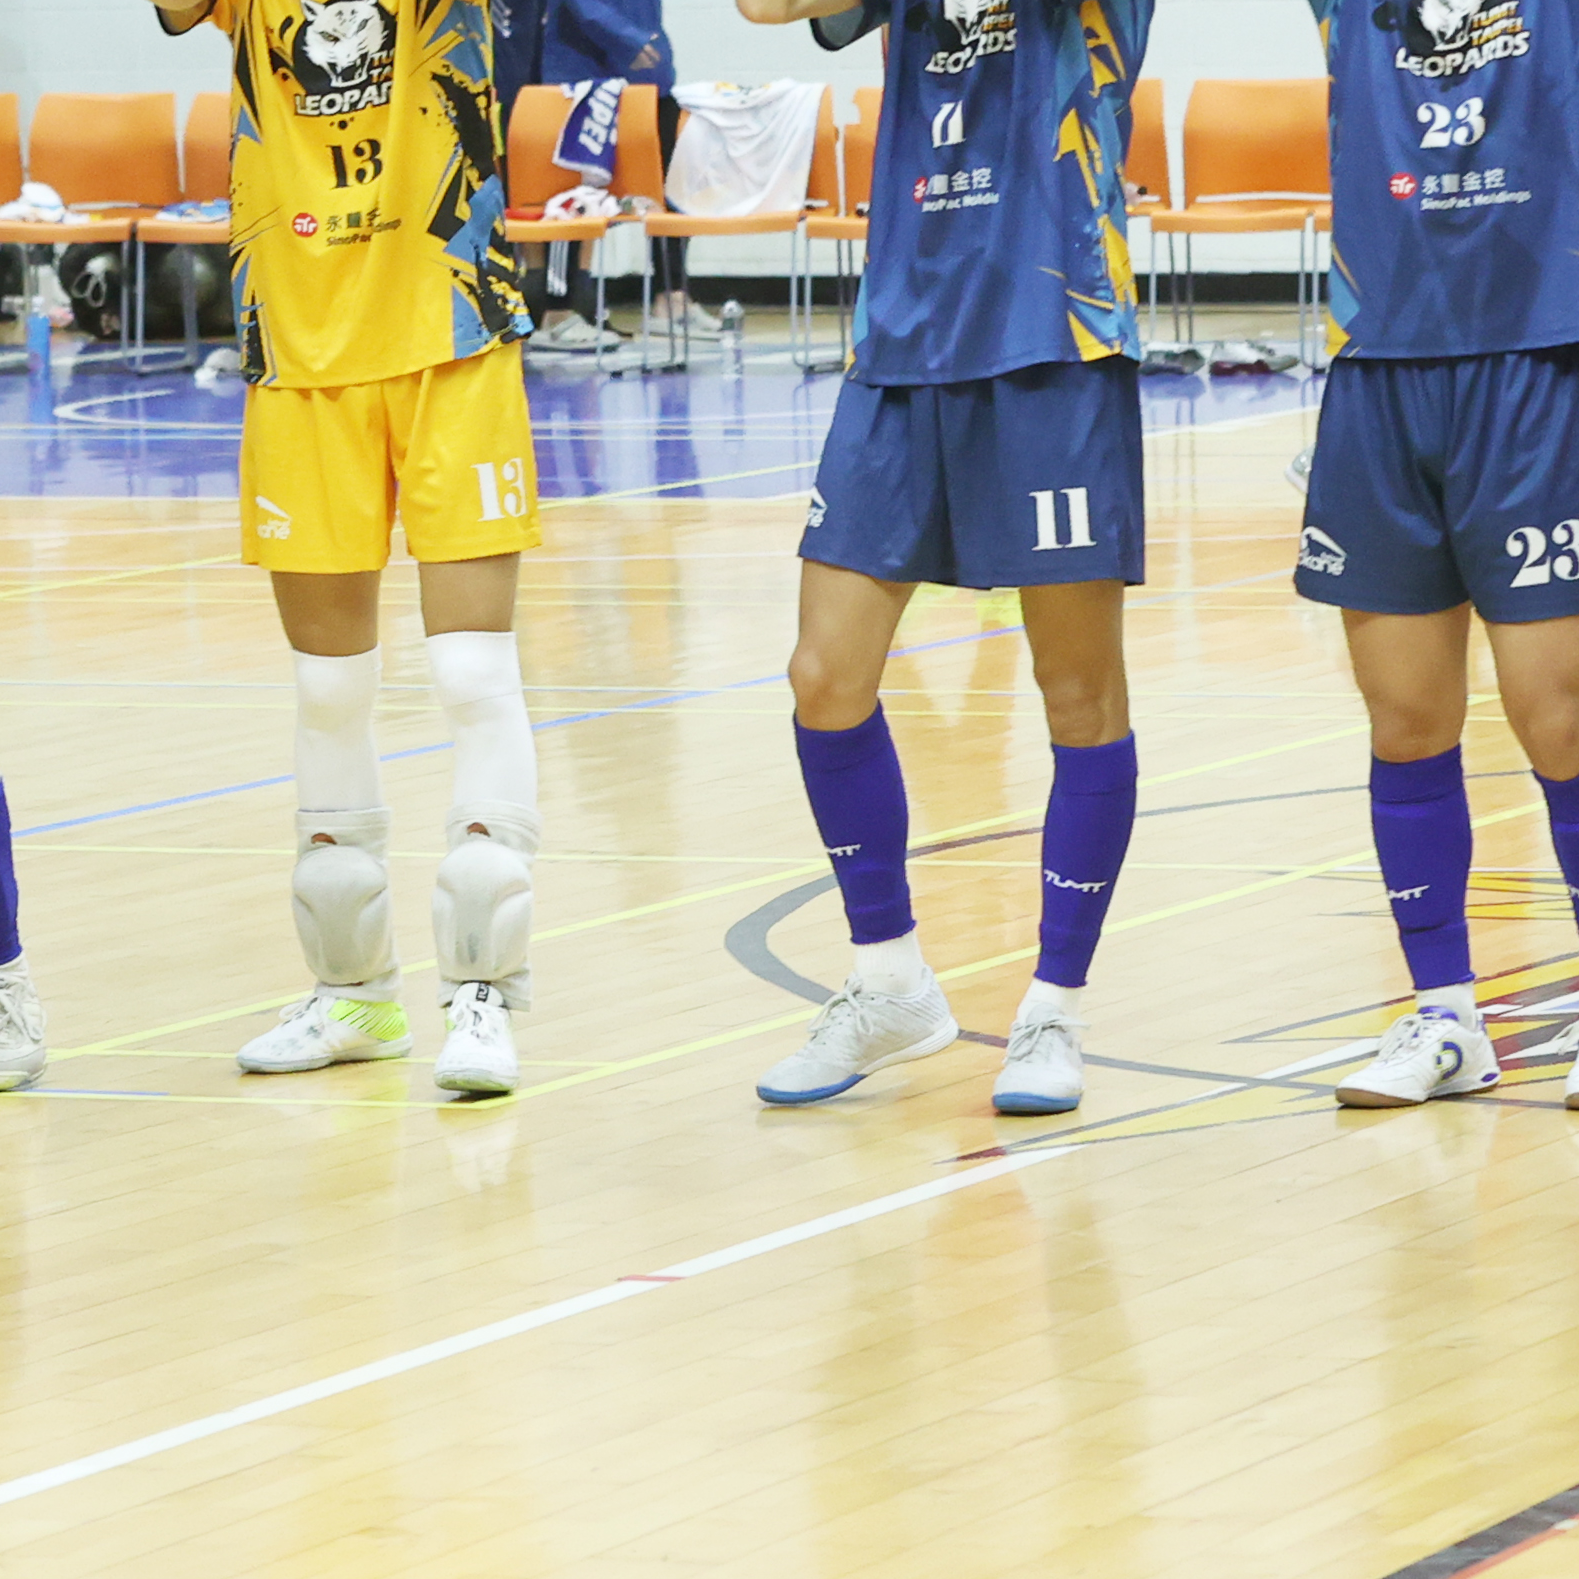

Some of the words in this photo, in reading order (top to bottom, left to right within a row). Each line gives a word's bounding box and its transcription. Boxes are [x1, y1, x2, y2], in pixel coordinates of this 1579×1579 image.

[1395, 31, 1530, 78] LEOPARDS
[294, 80, 394, 117] LEOPAR
[1417, 96, 1486, 149] 23
[326, 138, 384, 190] 13
[472, 457, 526, 523] 13
[1029, 487, 1096, 551] 11
